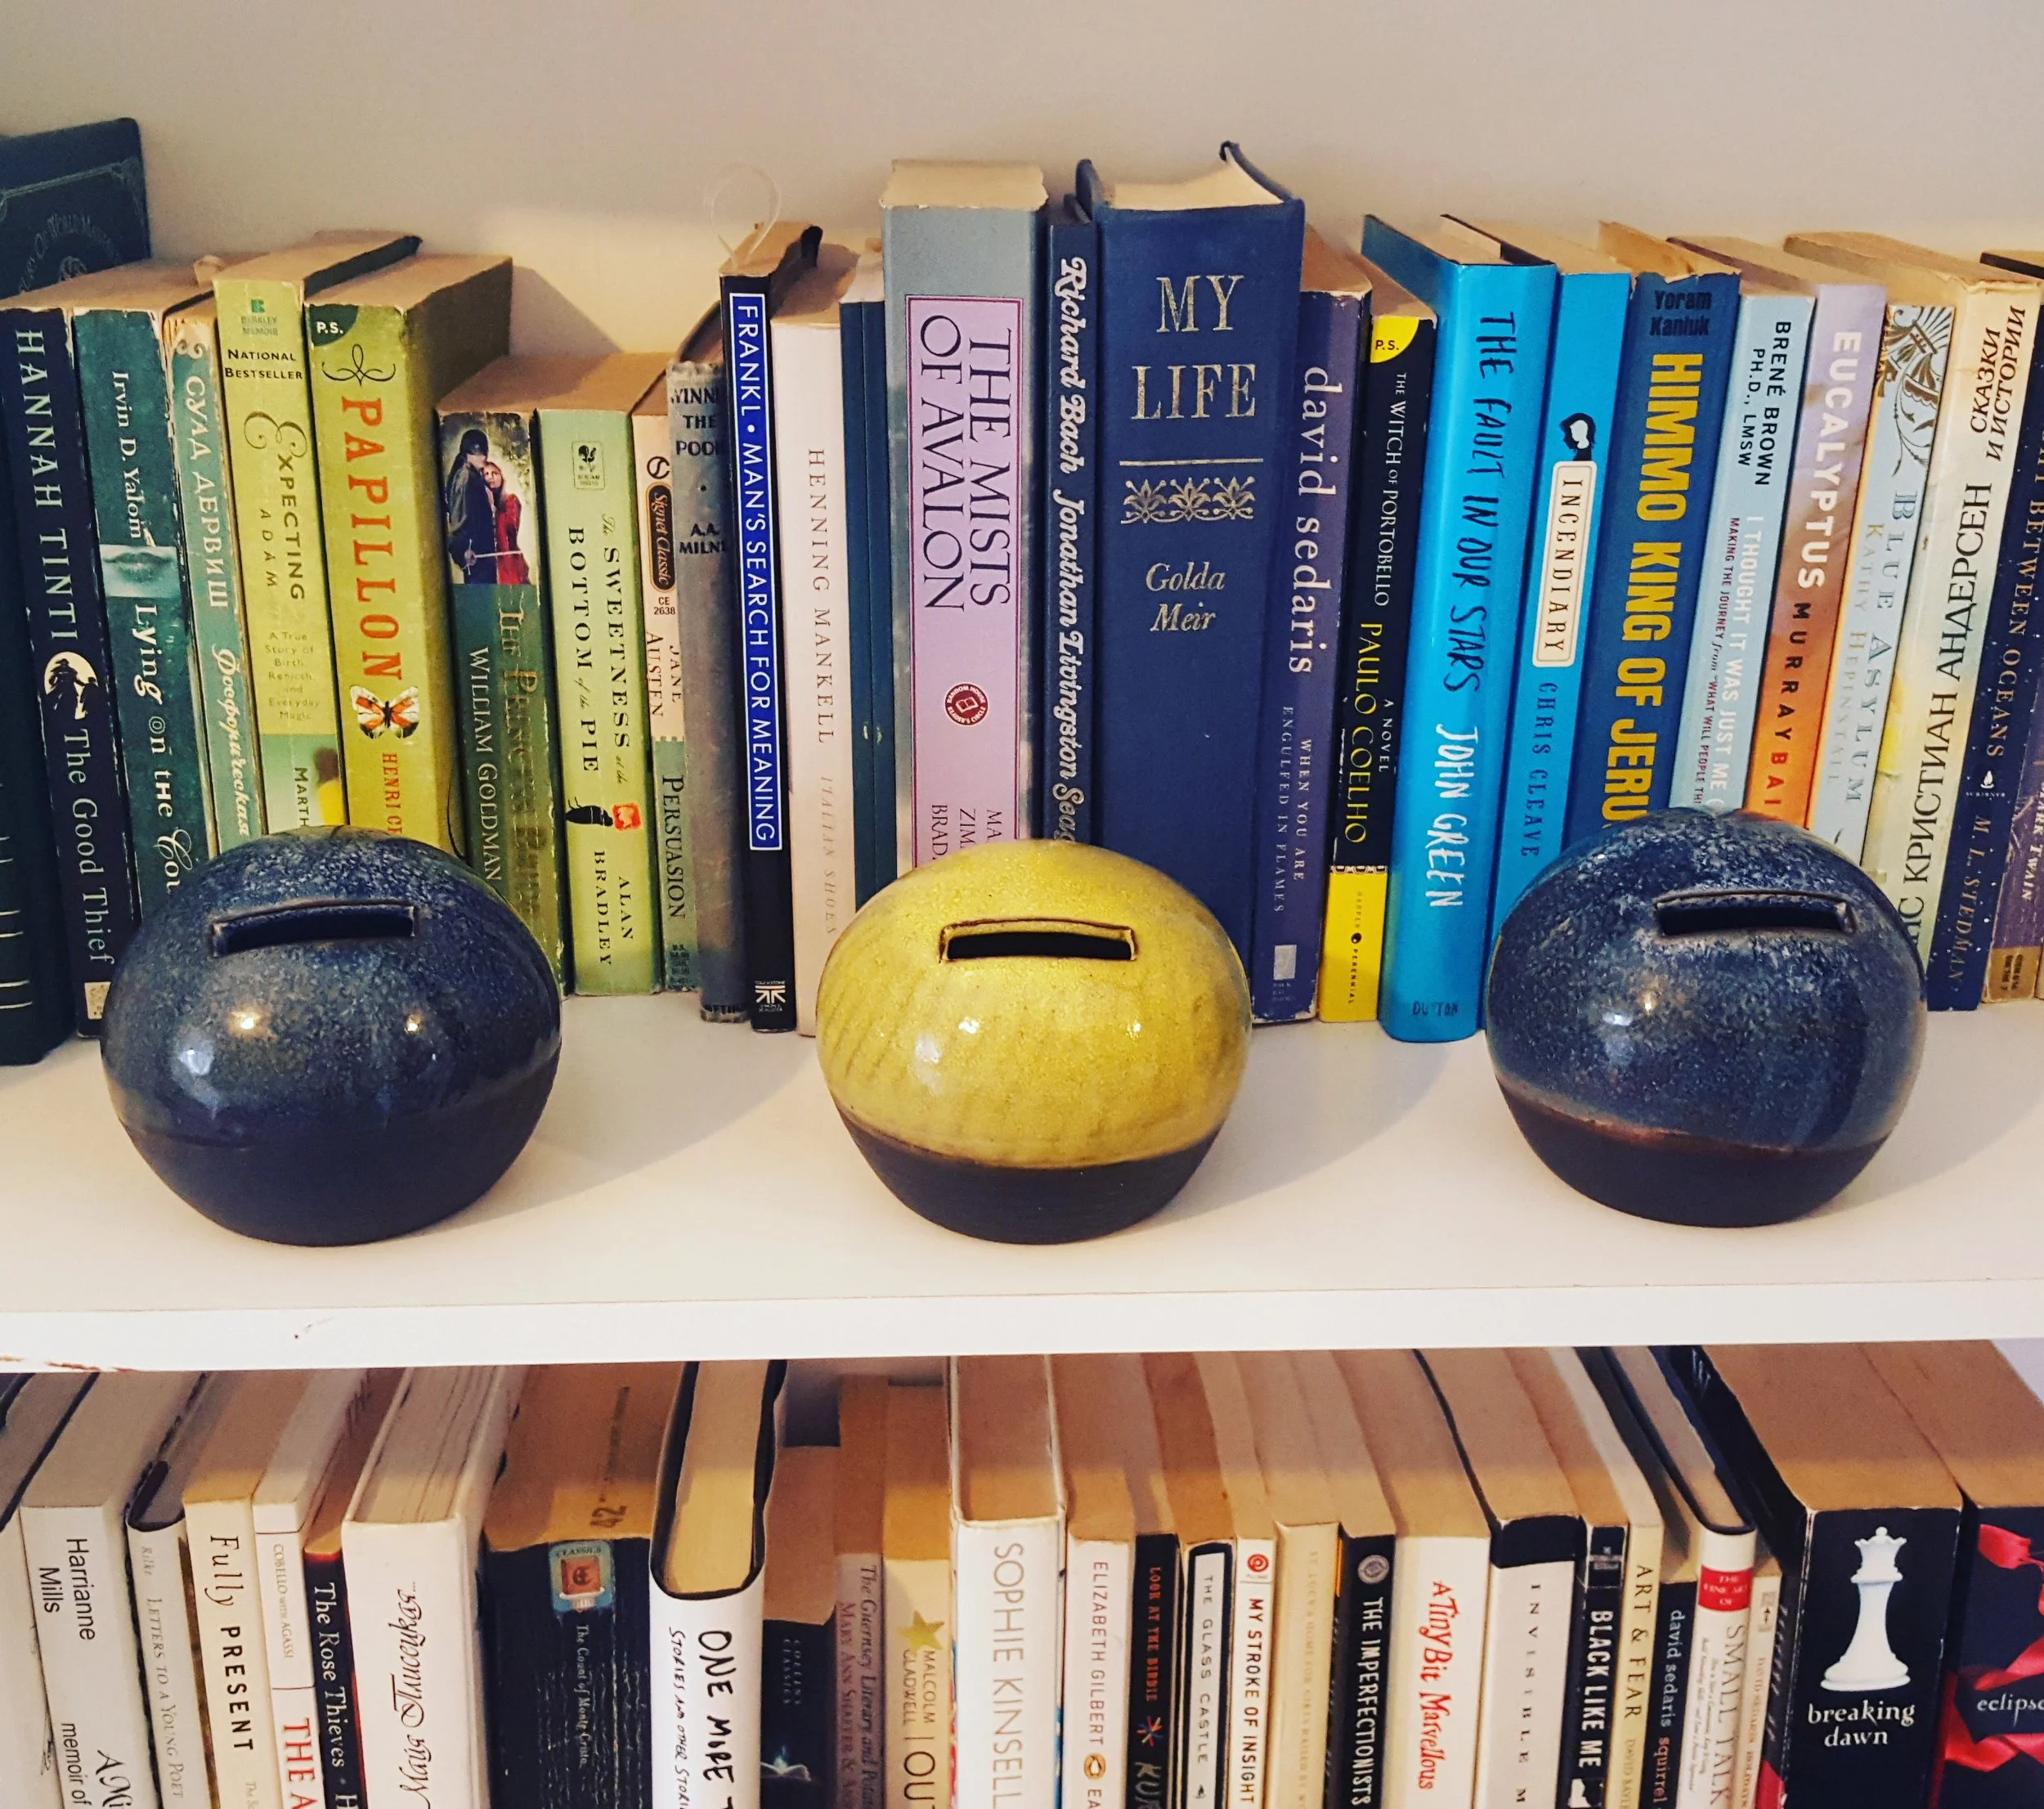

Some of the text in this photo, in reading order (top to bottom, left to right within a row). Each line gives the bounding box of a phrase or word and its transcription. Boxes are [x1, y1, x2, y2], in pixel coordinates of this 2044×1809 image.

[225, 367, 303, 379] BESTSELLER
[227, 348, 296, 362] NATIONAL
[316, 321, 343, 334] P.S.
[1155, 274, 1245, 333] MY
[1374, 339, 1400, 352] P.S.
[1648, 316, 1711, 338] Kaniuk
[1653, 290, 1713, 311] Yoram
[682, 414, 717, 429] THE
[1130, 363, 1257, 420] LIFE
[1635, 352, 1704, 522] HIMMO
[1737, 414, 1757, 467] LMSW
[1755, 321, 1792, 487] BRENÉ BROWN
[1969, 326, 2001, 434] СКАЗКИ
[1985, 304, 2026, 463] И ИСТОРИИ
[16, 330, 78, 640] HANNAH TINTI
[110, 370, 143, 540] Irvin D. Yalom
[186, 375, 230, 608] СУАД ДЕРВИШ
[244, 411, 307, 600] EXPECTING
[919, 315, 965, 613] OF AVALON
[969, 327, 1011, 607] THE MISTS
[1052, 256, 1087, 781] Richard Bach Jonathan Livingston
[1289, 366, 1343, 675] david sedaris
[1374, 372, 1406, 608] THE WITCH OF PORTOBELLO
[1442, 311, 1518, 693] THE FAULT IN OUR STARS
[260, 509, 278, 587] ADAM
[341, 396, 403, 680] PAPILLON
[655, 536, 671, 588] Classic
[658, 596, 670, 606] CE
[737, 305, 776, 842] FRANKL MAN'S SEARCH FOR MEANING
[808, 448, 834, 743] HENNING MANKELL
[1145, 560, 1226, 592] Golda
[1544, 478, 1584, 653] INCENDIARY
[1621, 541, 1683, 641] KING
[1773, 330, 1863, 742] EUCALYPTUS MURRAY
[133, 604, 163, 705] Lying
[568, 527, 599, 772] BOTTOM PIE
[603, 547, 630, 748] SWEETNESS
[646, 631, 664, 717] AUSTEN
[653, 606, 676, 616] 2638
[669, 645, 684, 703] JANE
[1150, 600, 1217, 632] Meir
[1615, 657, 1667, 707] OF
[1696, 517, 1741, 784] MAKING THE JOURNEY PEOPLE
[1709, 531, 1761, 791] THOUGHT IT WAS JUST ME
[1845, 490, 1918, 803] BLUE ASYLUM
[1903, 483, 1993, 884] КРИСТИАН АНДЕРСЕН
[468, 646, 501, 882] WILLIAM GOLDMAN
[1344, 622, 1383, 844] PAULO COELHO
[1378, 717, 1394, 773] NOVEL
[1521, 681, 1558, 858] CHRIS CLEAVE
[1986, 647, 2022, 757] OCEANS
[64, 728, 115, 965] The Good Thief
[383, 752, 401, 809] HENRI
[661, 774, 688, 920] PERSUASION
[1273, 707, 1293, 913] ENGULFED IN FLAMES
[1293, 738, 1312, 881] WHEN YOU ARE
[1424, 724, 1479, 908] JOHN GREEN
[594, 851, 612, 966] BRADLEY
[619, 876, 634, 940] ALAN
[38, 1567, 65, 1614] Mills
[66, 1538, 96, 1641] Harrianne
[204, 1535, 253, 1751] Fully PRESENT
[669, 1627, 687, 1692] STORIES
[993, 1542, 1024, 1663] SOPHIE
[1089, 1561, 1109, 1746] ELIZABETH GILBERT
[1625, 1564, 1654, 1719] ART & FEAR
[314, 1582, 349, 1768] The Rose Thieves
[697, 1630, 737, 1699] ONE
[923, 1650, 936, 1724] MALCOLM
[1197, 1575, 1213, 1764] THE GLASS CASTLE
[1239, 1598, 1264, 1805] MY STROKE OF INSIGHT
[1351, 1597, 1384, 1807] THE IMPERFECTIONISTS
[1418, 1579, 1461, 1790] A Tiny Bit Marvellous
[1518, 1583, 1541, 1764] INVISIBLE
[1578, 1610, 1614, 1770] BLACK LIKE ME
[1661, 1609, 1686, 1728] david sedaris
[1717, 1624, 1746, 1723] SMALL
[1807, 1699, 1916, 1728] breaking
[1823, 1726, 1889, 1748] dawn
[61, 1722, 92, 1806] memoir of
[283, 1717, 316, 1784] THE
